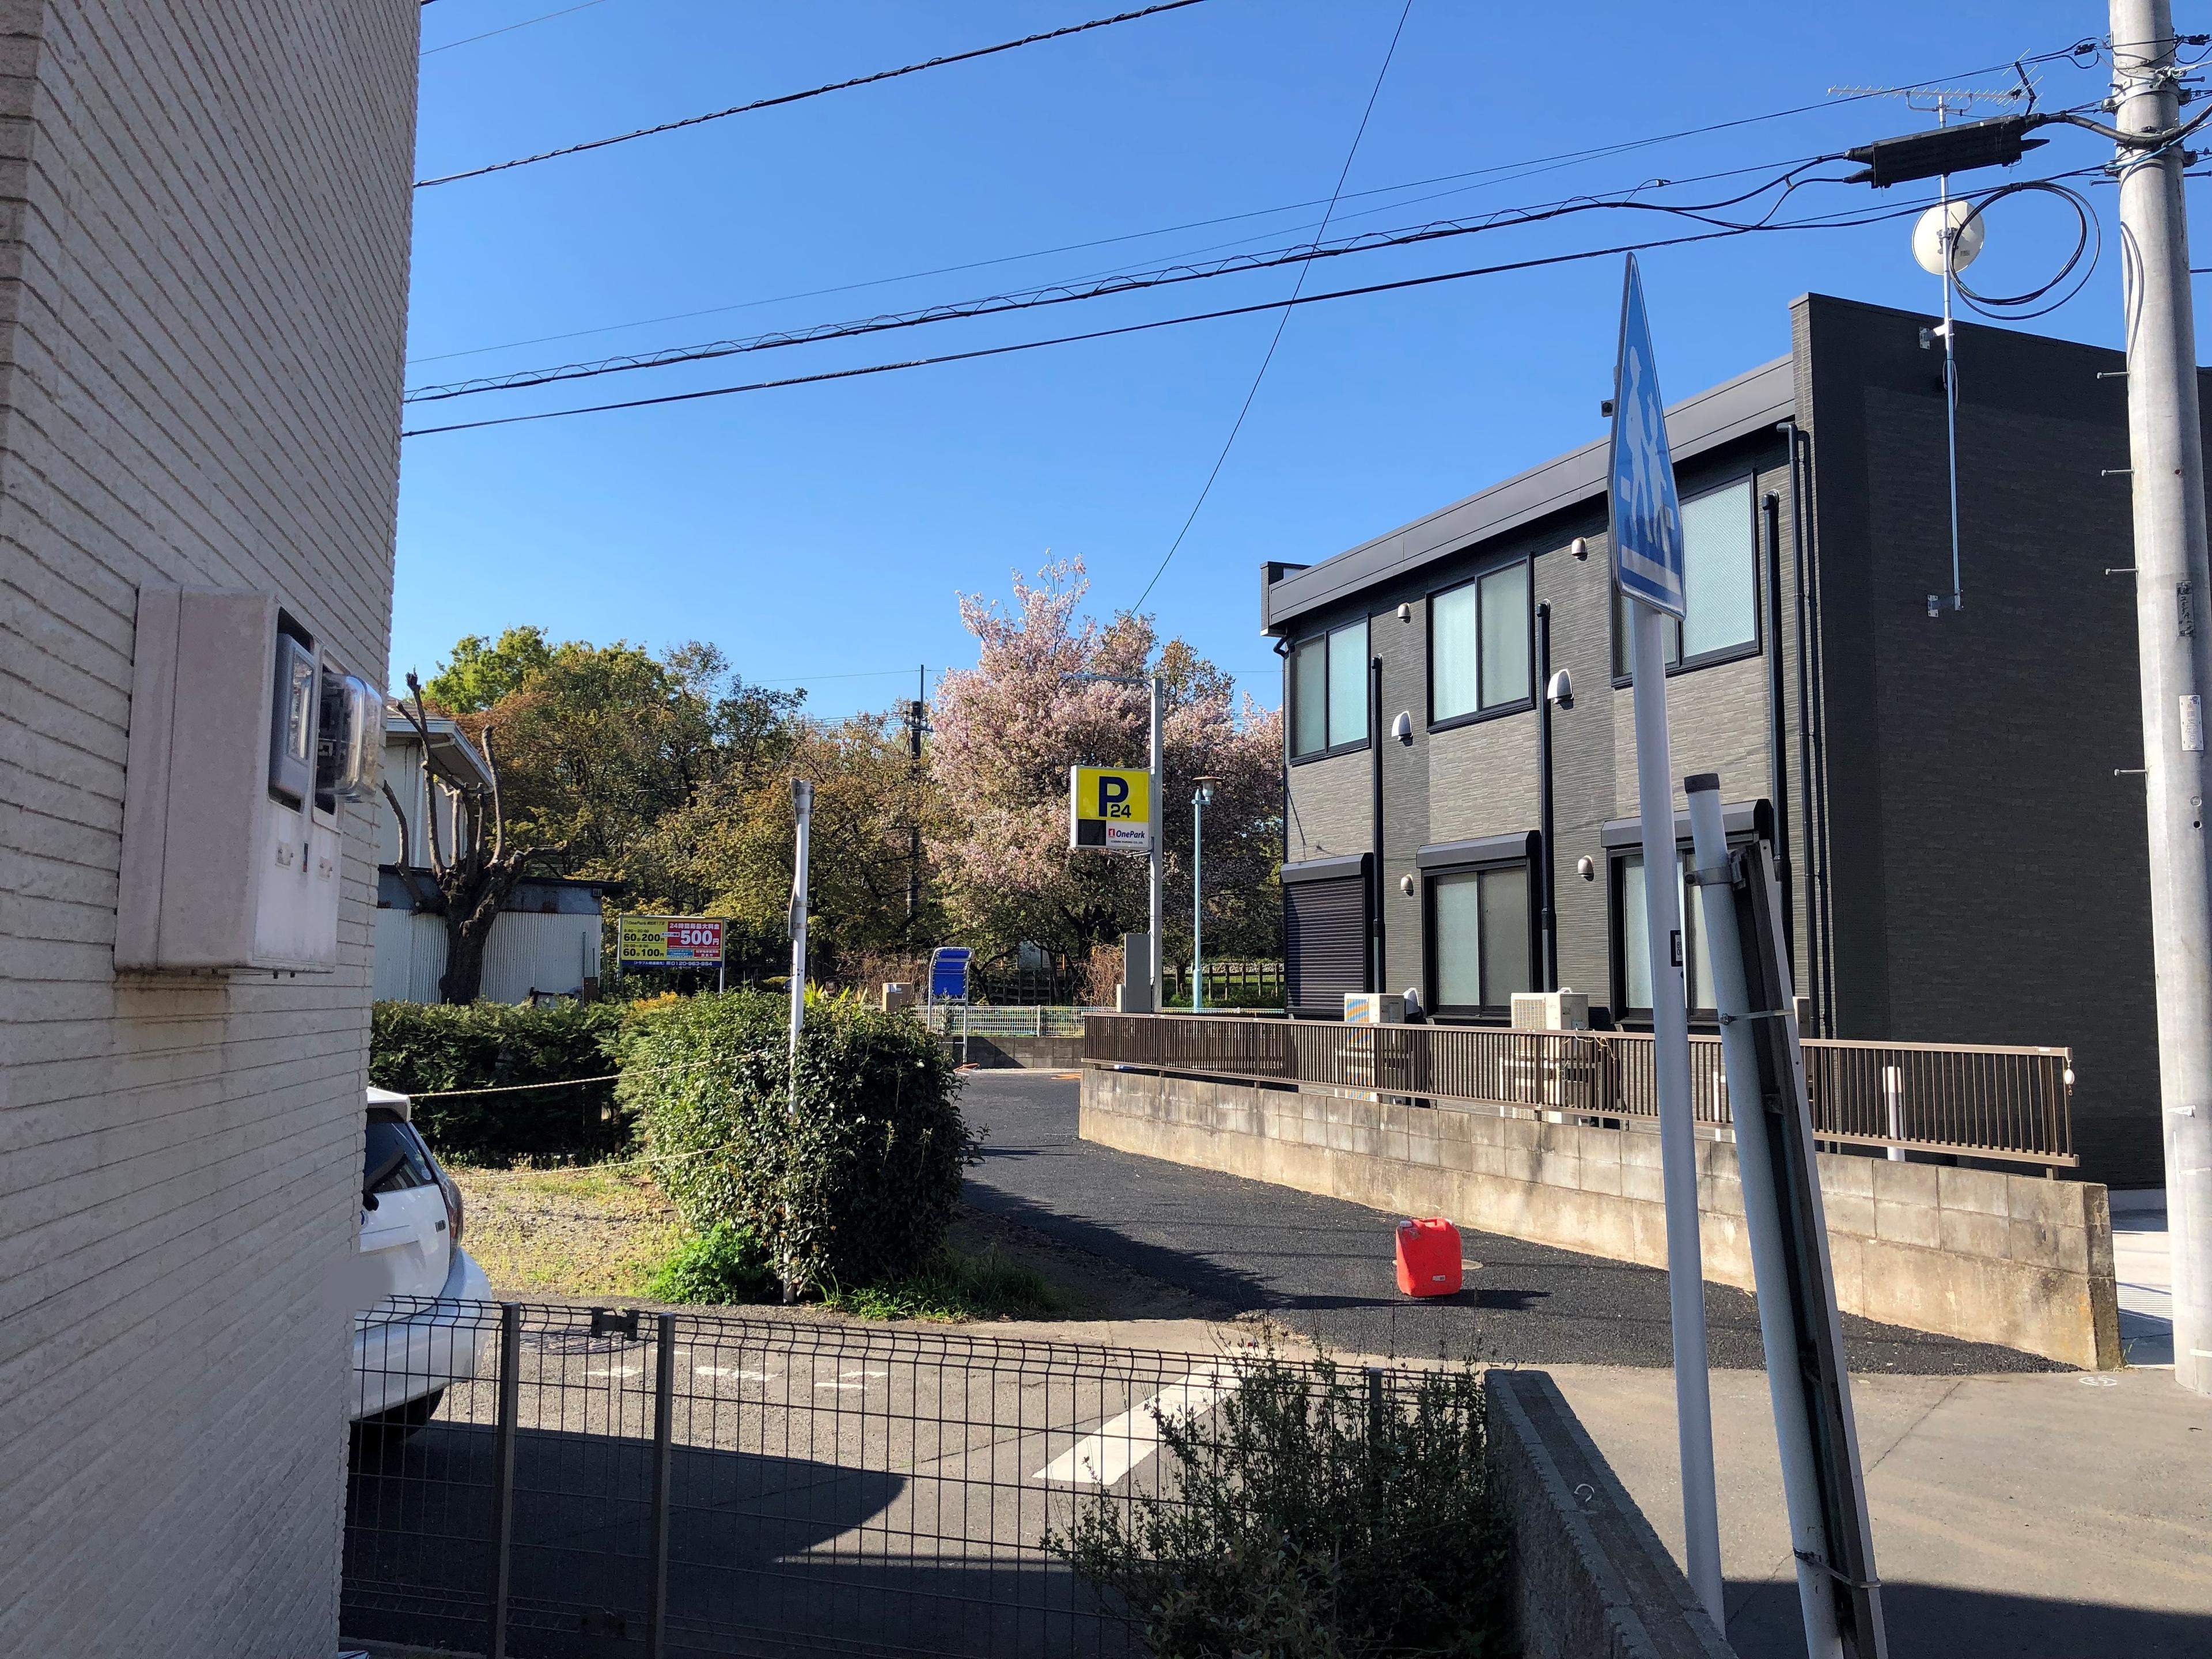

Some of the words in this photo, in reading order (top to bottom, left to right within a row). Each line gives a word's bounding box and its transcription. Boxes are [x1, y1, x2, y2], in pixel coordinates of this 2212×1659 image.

[1099, 776, 1128, 817] P
[1111, 804, 1131, 818] 24
[1116, 830, 1145, 839] OnePark
